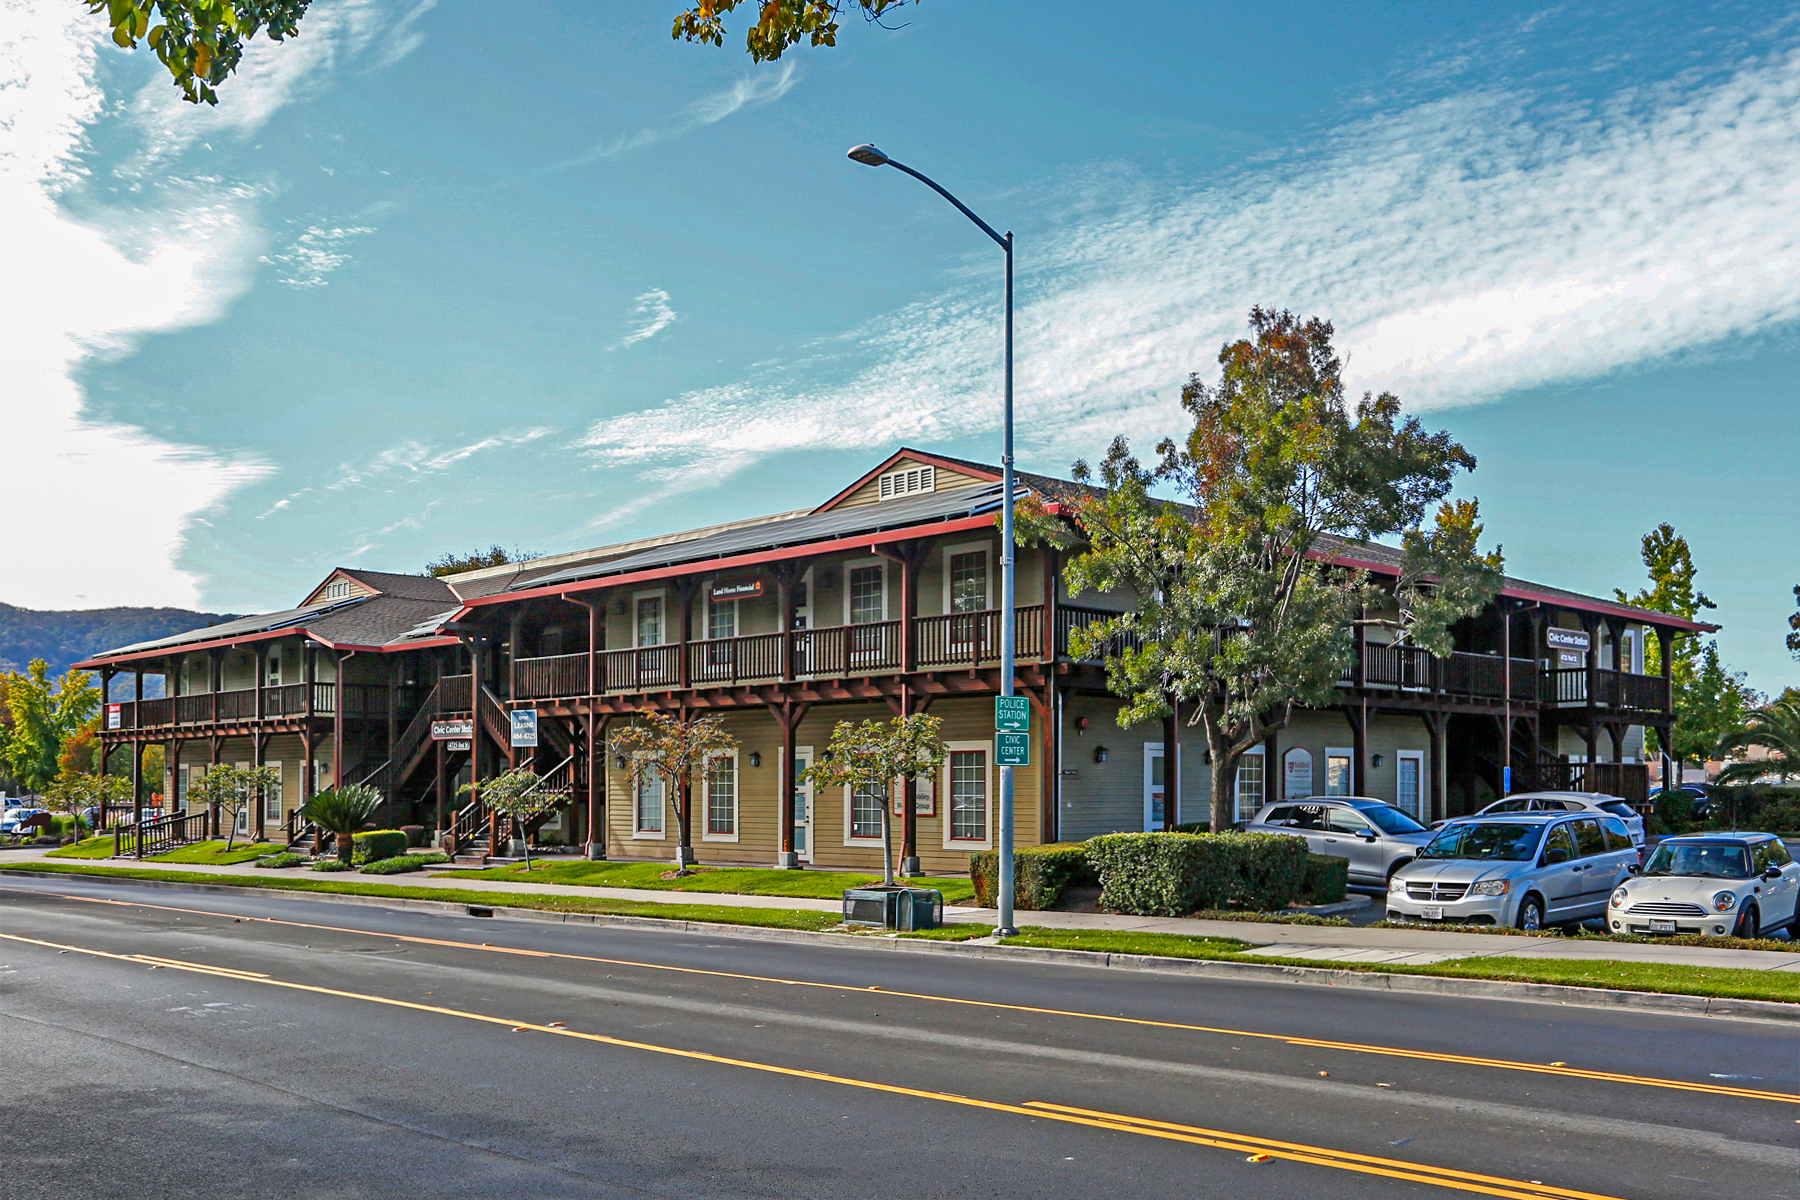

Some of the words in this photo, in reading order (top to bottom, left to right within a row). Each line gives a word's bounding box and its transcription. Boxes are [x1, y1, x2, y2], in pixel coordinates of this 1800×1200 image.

[1549, 632, 1560, 642] Civic
[1560, 634, 1574, 644] Center
[1574, 636, 1588, 645] Station
[1000, 699, 1025, 709] POLICE
[999, 710, 1026, 720] STATION
[433, 726, 445, 734] Civic
[445, 725, 461, 734] Center
[513, 721, 534, 729] LEASING
[1005, 735, 1021, 744] CIVIC
[1001, 746, 1025, 755] CENTER
